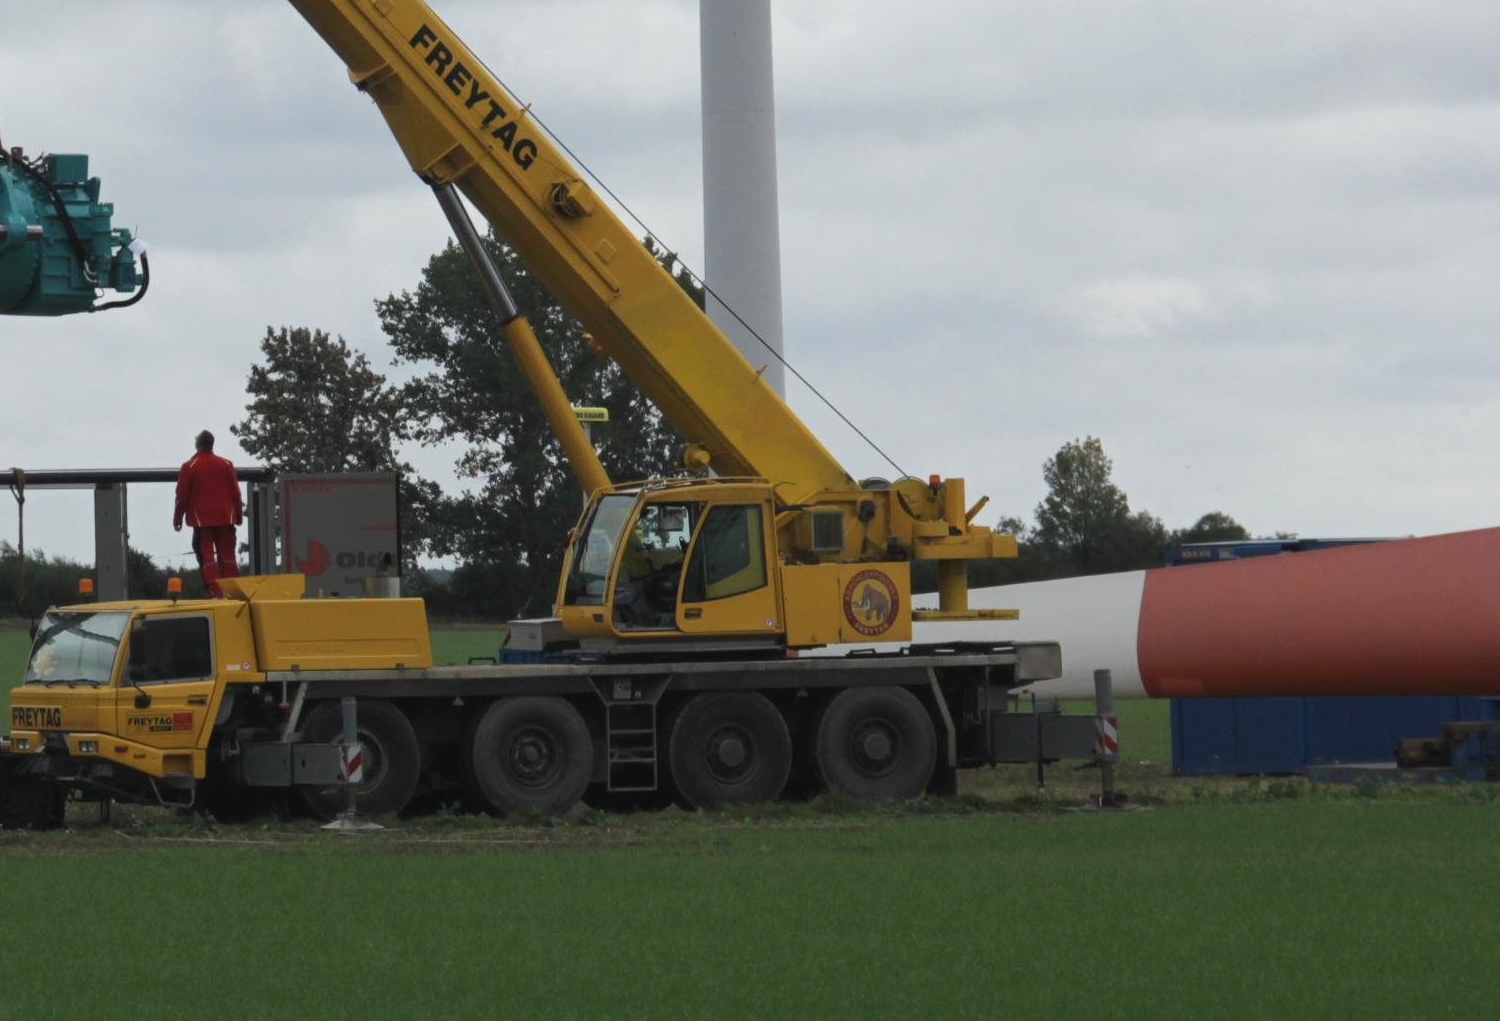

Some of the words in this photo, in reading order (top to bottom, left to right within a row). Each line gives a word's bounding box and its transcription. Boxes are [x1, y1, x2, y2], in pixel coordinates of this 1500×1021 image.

[409, 24, 537, 171] FREYTAG
[12, 707, 61, 728] FREYTAG
[128, 716, 173, 726] FREYTAG
